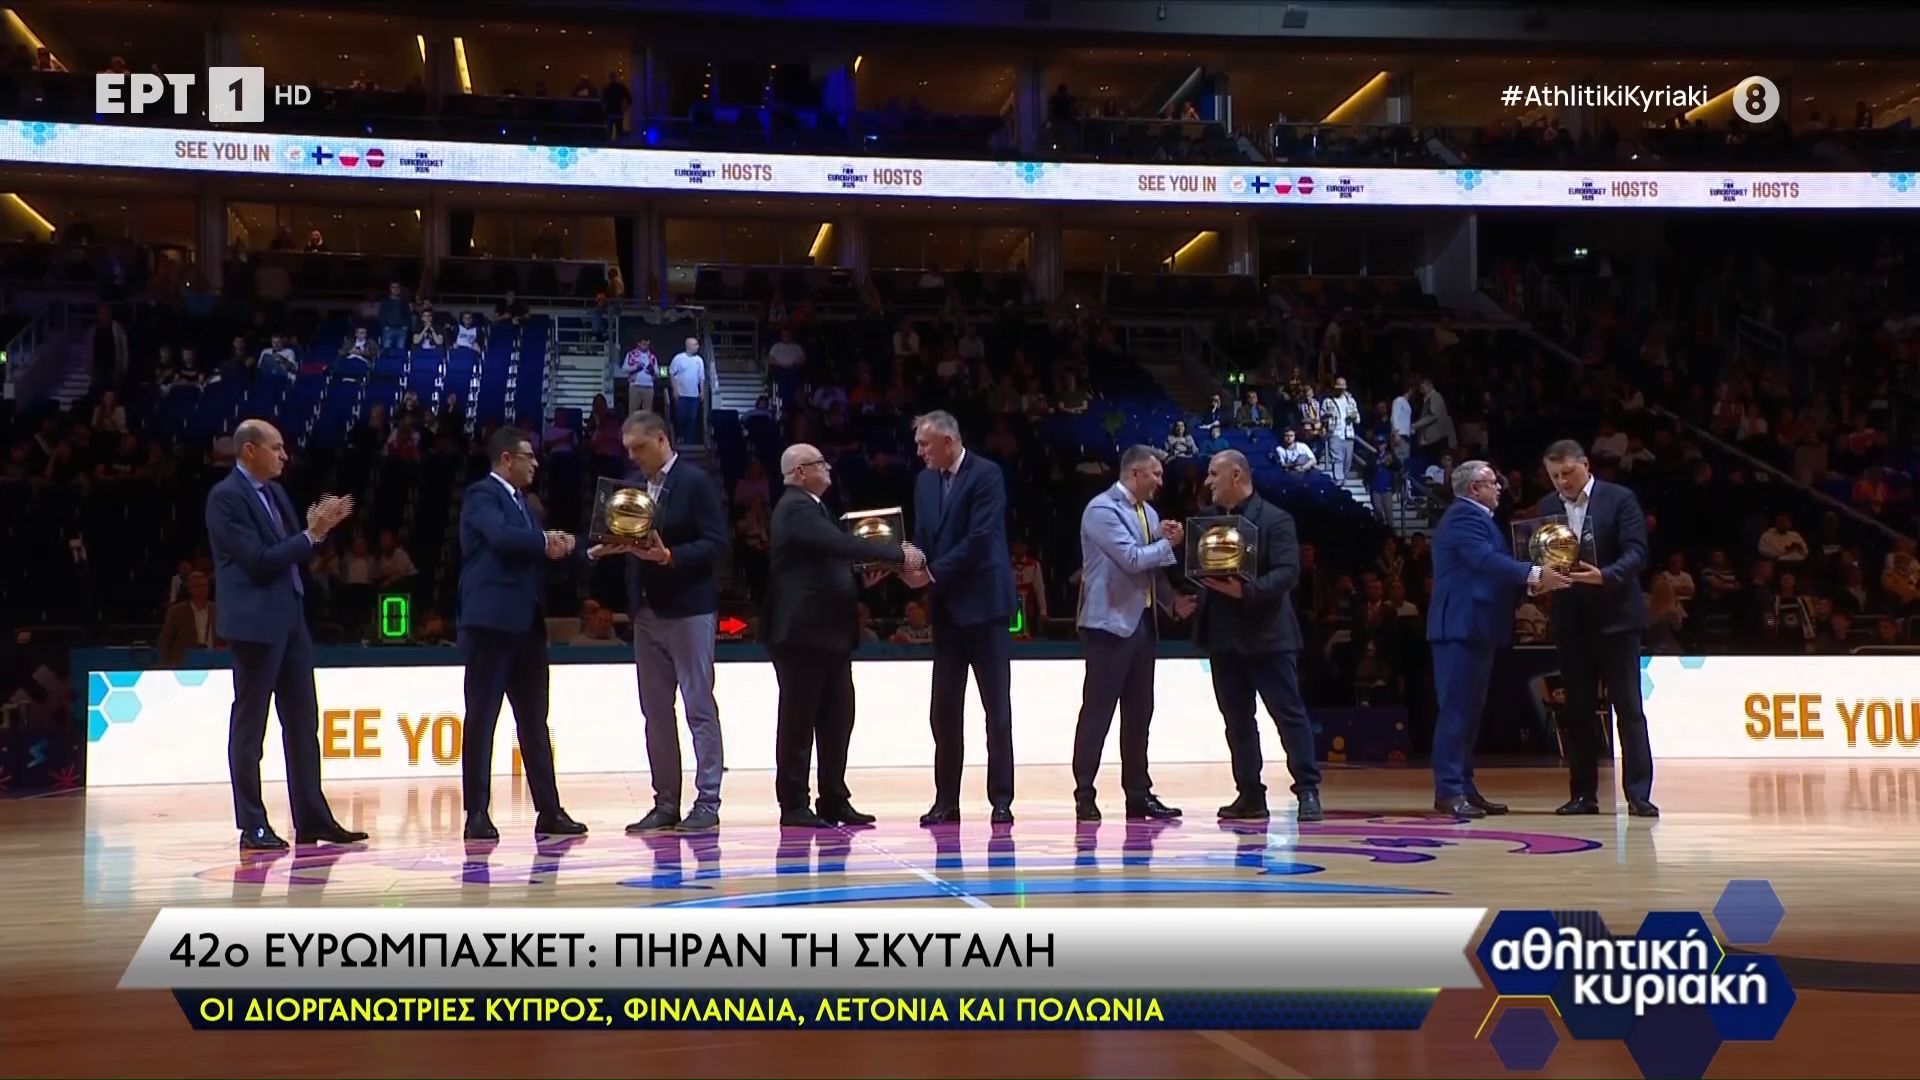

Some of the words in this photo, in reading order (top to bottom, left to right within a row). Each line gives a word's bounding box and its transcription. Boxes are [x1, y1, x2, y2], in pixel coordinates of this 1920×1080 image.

[175, 140, 208, 158] SEE
[213, 142, 248, 160] YOU
[253, 144, 270, 161] IN
[722, 163, 772, 181] HOSTS
[873, 168, 922, 186] HOSTS
[1138, 175, 1165, 191] SEE
[1169, 175, 1199, 192] YOU
[1203, 176, 1216, 192] IN
[1611, 181, 1658, 197] HOSTS
[1752, 182, 1799, 199] HOSTS
[383, 597, 406, 636] 0
[1745, 693, 1824, 739] SEE
[1836, 697, 1920, 748] YOU
[323, 709, 382, 759] EE
[397, 713, 463, 766] YO
